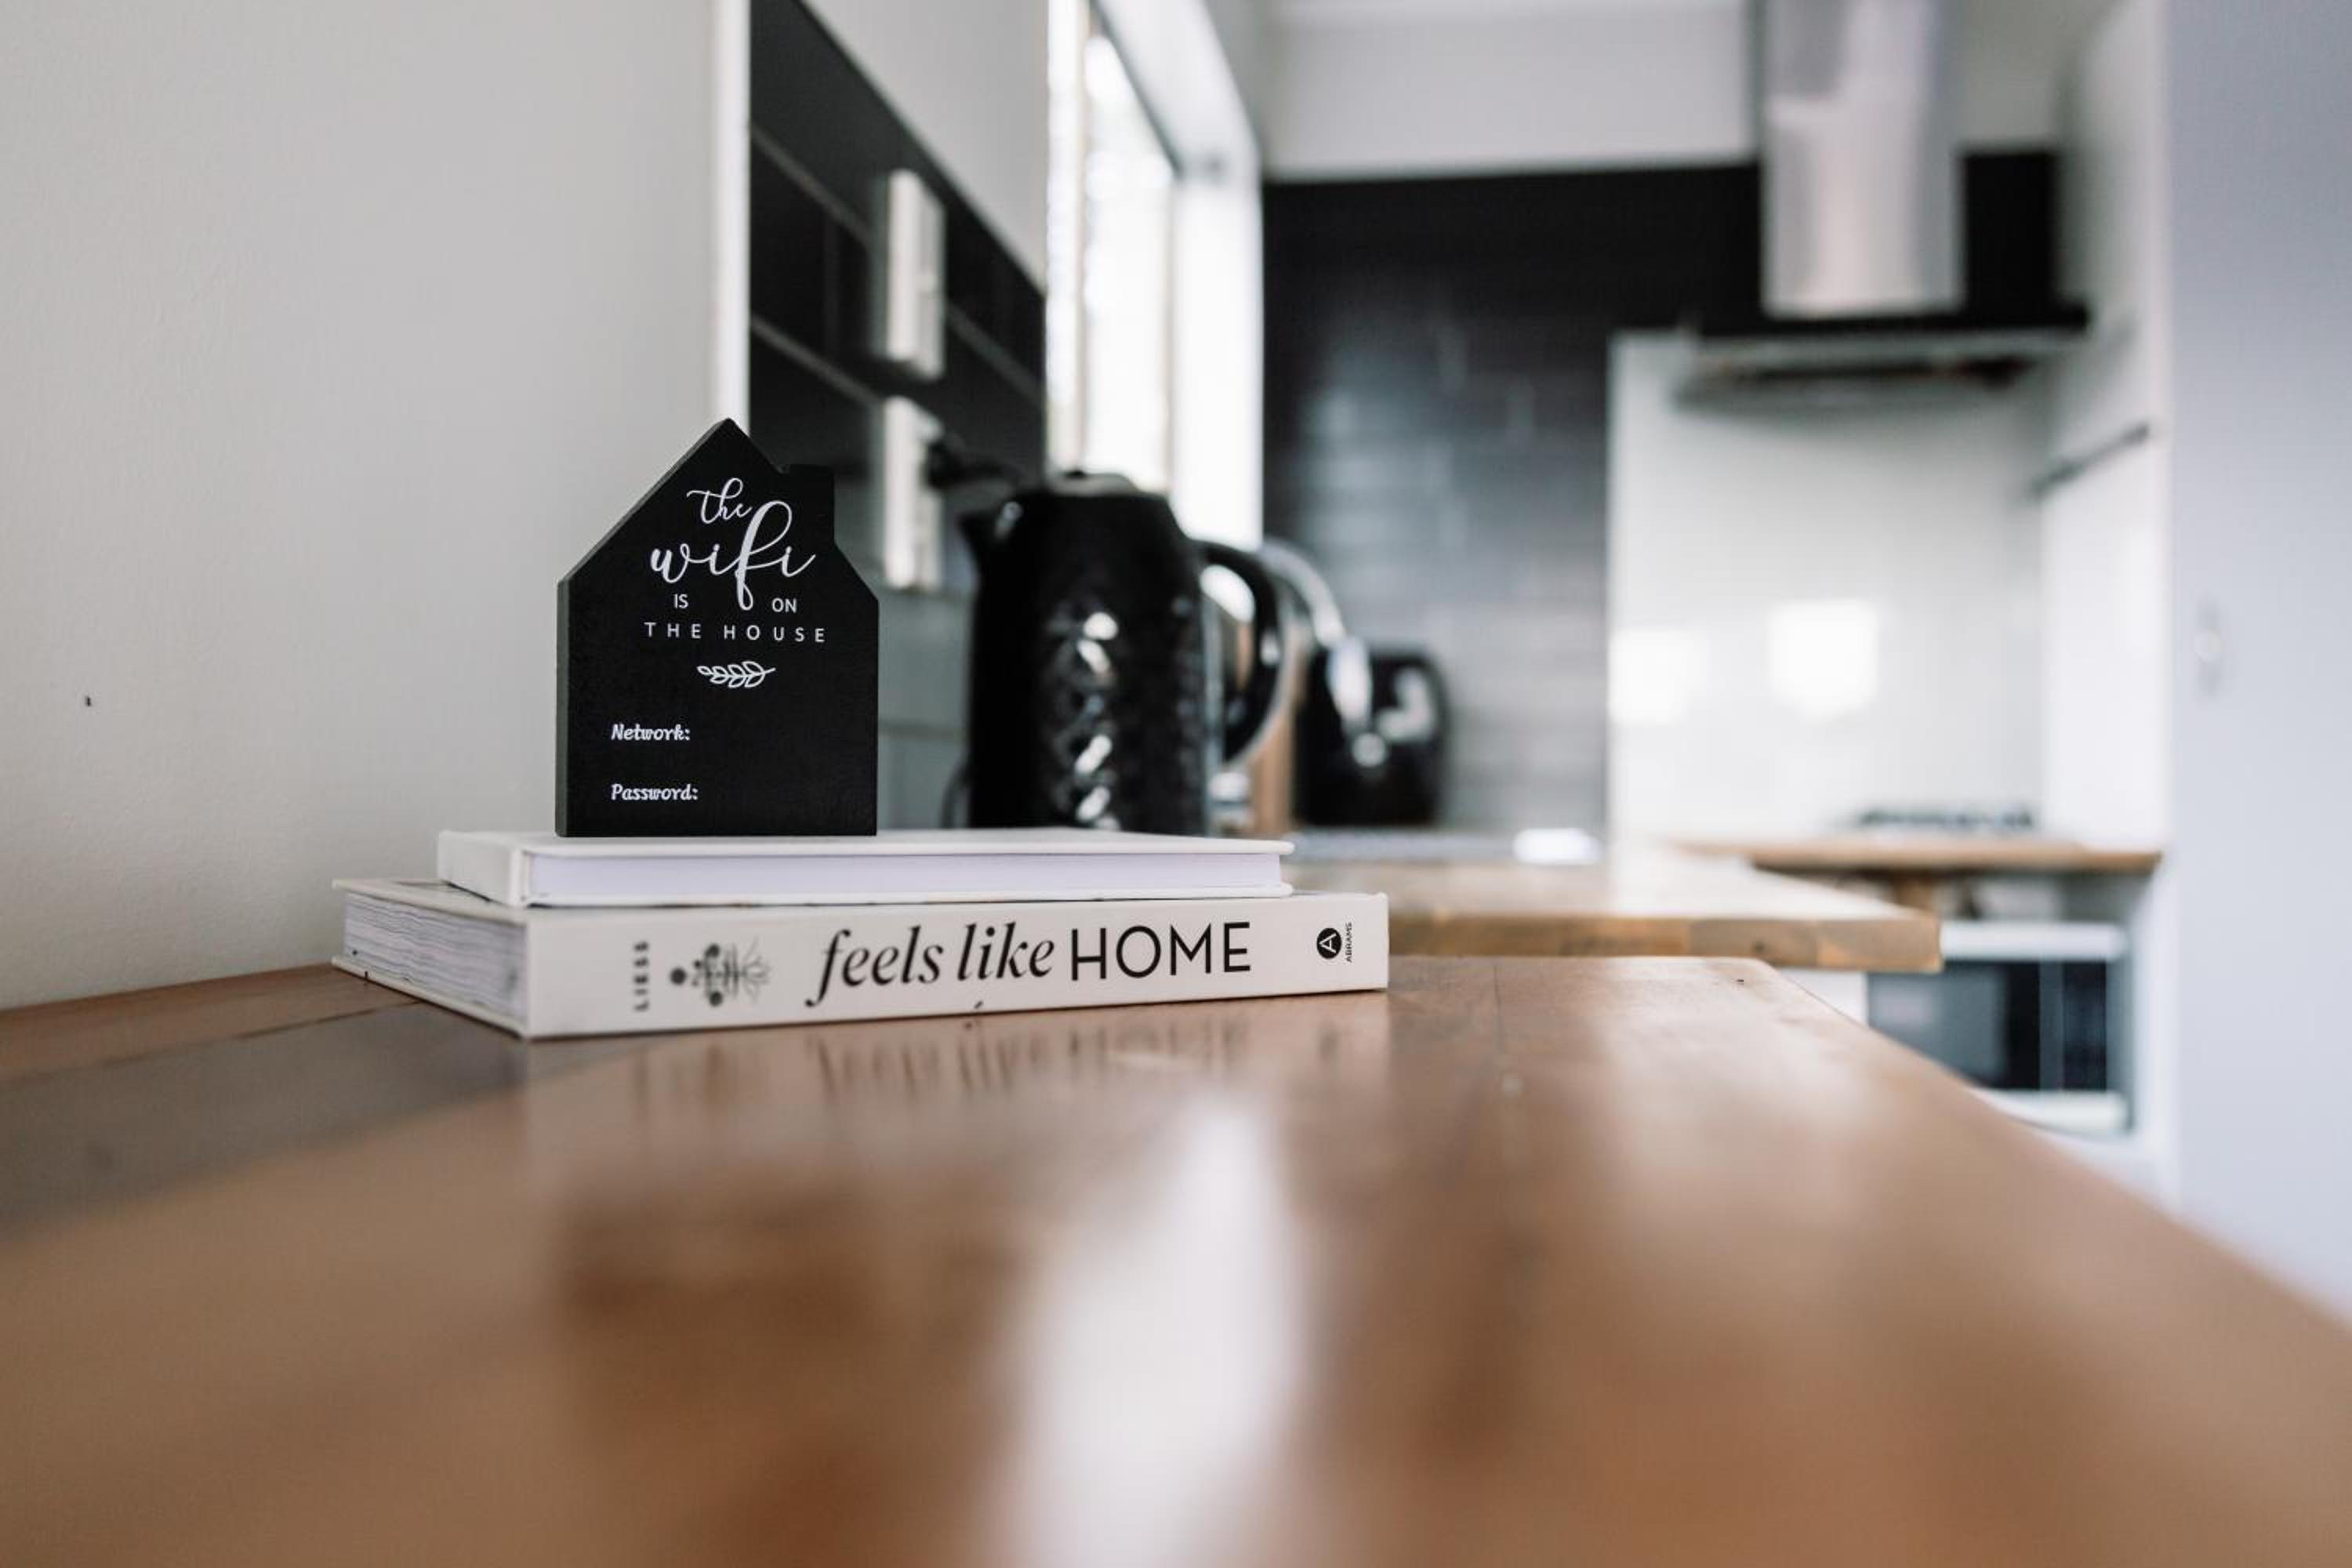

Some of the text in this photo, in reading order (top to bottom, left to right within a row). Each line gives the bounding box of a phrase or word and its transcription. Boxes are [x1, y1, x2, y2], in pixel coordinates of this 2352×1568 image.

[686, 477, 753, 524] the
[649, 500, 816, 611] wifi
[673, 593, 797, 613] IS ON
[644, 622, 826, 643] THE HOUSE
[611, 723, 691, 741] Network:
[611, 783, 699, 801] Password:
[1345, 922, 1353, 964] ABRAMS
[804, 920, 1251, 1007] feels like HOME
